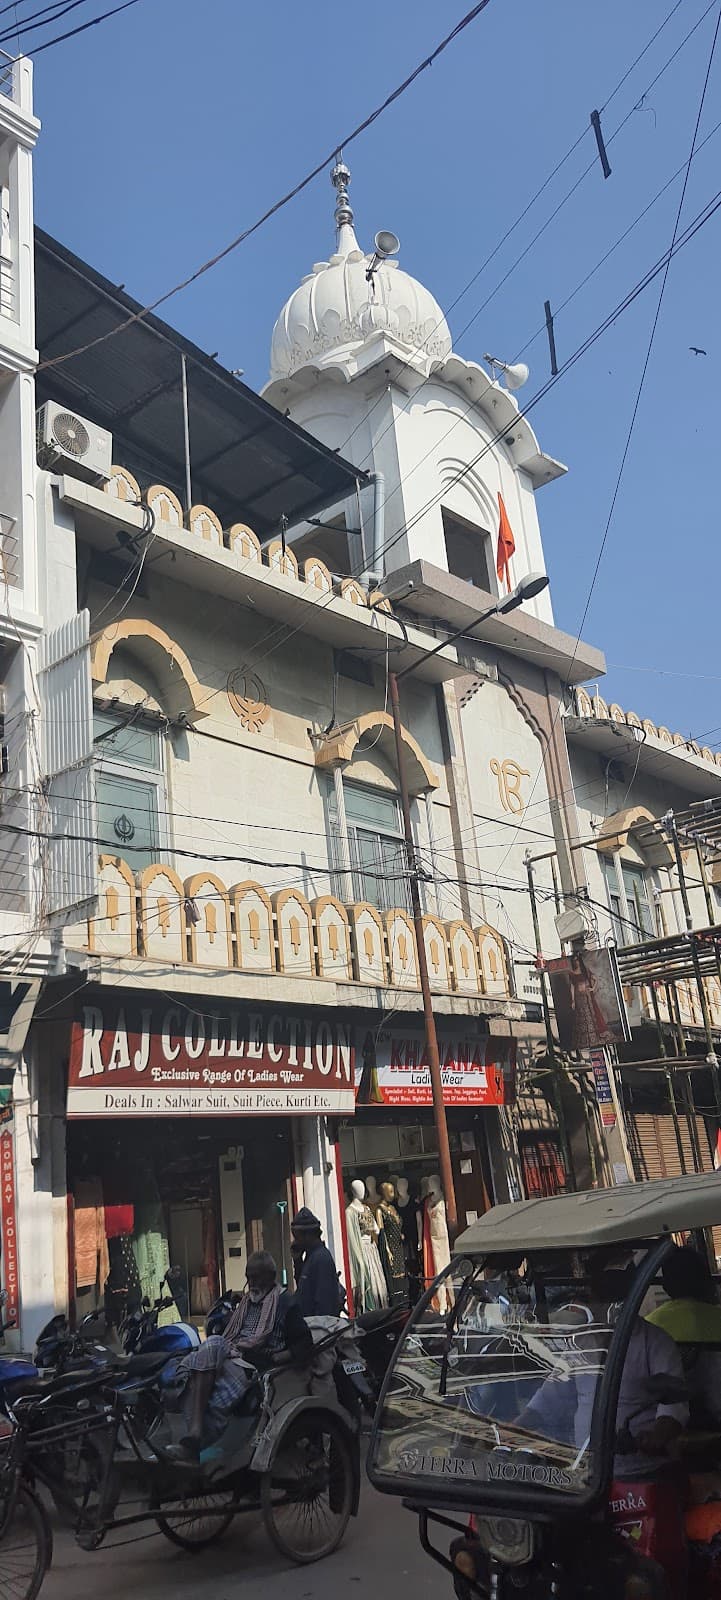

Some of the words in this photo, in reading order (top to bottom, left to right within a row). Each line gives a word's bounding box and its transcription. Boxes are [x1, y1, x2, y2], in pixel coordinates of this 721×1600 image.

[79, 1006, 153, 1078] RAJ
[161, 1007, 353, 1082] COLLECTION
[390, 1039, 485, 1073] KHAANA
[151, 1067, 200, 1081] Exclusive
[202, 1068, 232, 1083] Range
[234, 1069, 247, 1081] Of
[248, 1069, 278, 1082] Ladies
[280, 1070, 304, 1083] Wear
[441, 1075, 464, 1085] Wear
[104, 1094, 136, 1109] Deals
[140, 1095, 154, 1108] In
[165, 1095, 202, 1108] Salwar
[206, 1095, 230, 1109] Suit,
[256, 1096, 283, 1109] Piece,
[286, 1096, 311, 1108] Kurti
[314, 1096, 331, 1108] Etc.
[418, 1456, 477, 1476] TERRA
[487, 1461, 574, 1485] MOTORS
[608, 1492, 646, 1513] ERRA
